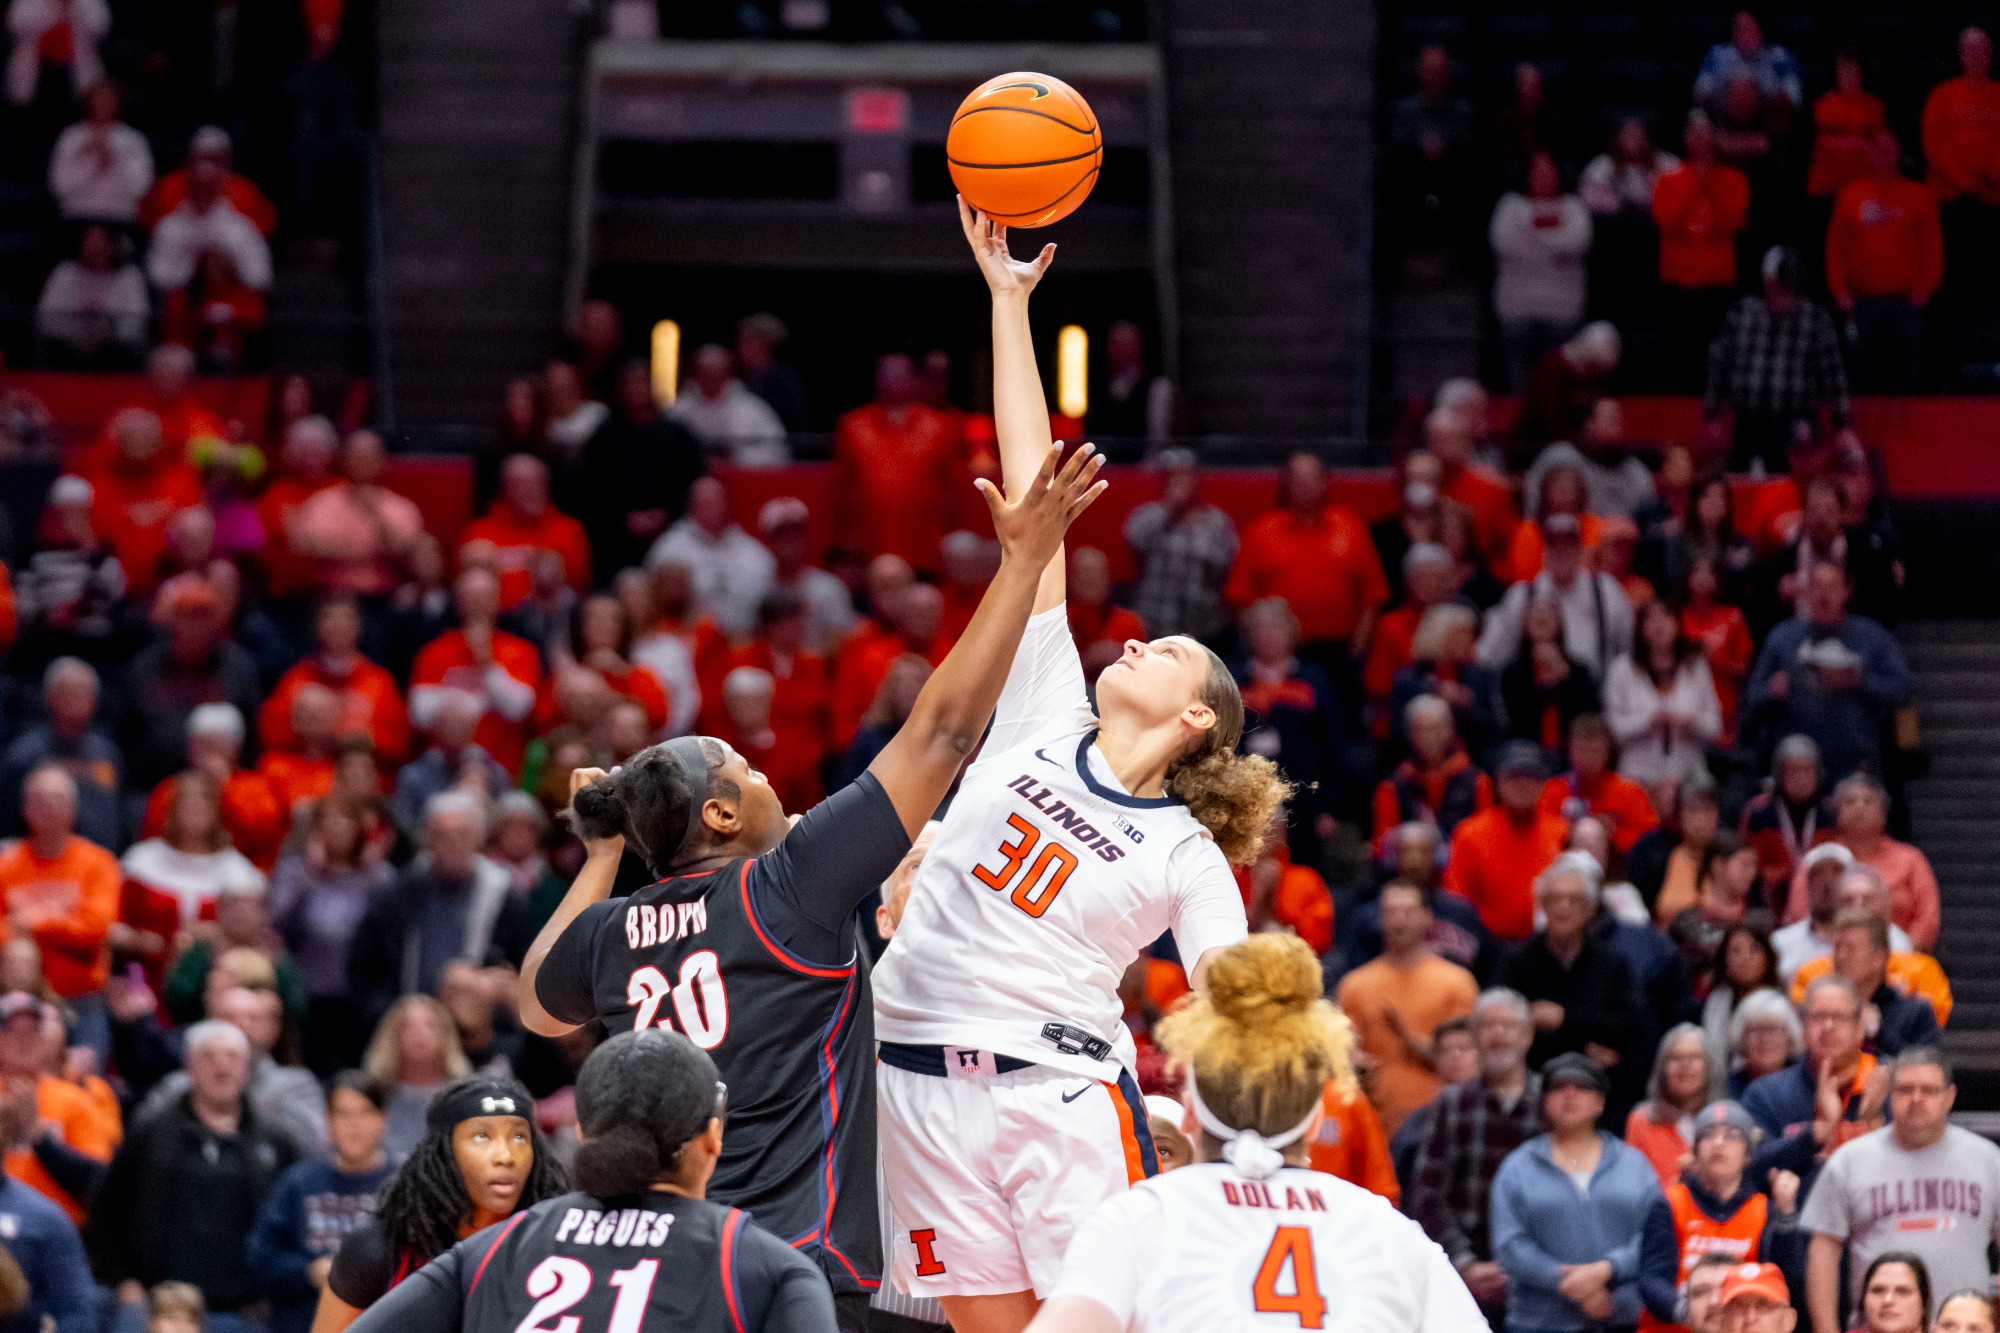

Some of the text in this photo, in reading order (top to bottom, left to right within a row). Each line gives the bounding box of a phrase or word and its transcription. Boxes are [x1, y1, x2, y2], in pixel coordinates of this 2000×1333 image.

[1006, 773, 1126, 863] ILLINOIS
[971, 811, 1079, 919] 30
[625, 895, 708, 950] BROWN
[626, 949, 730, 1051] 20
[1087, 1042, 1100, 1052] 44
[555, 1207, 676, 1248] PEGUES
[1221, 1180, 1329, 1213] DOLAN
[1870, 1177, 1982, 1220] ILLINOIS
[514, 1254, 662, 1333] 21
[1252, 1224, 1328, 1330] 4
